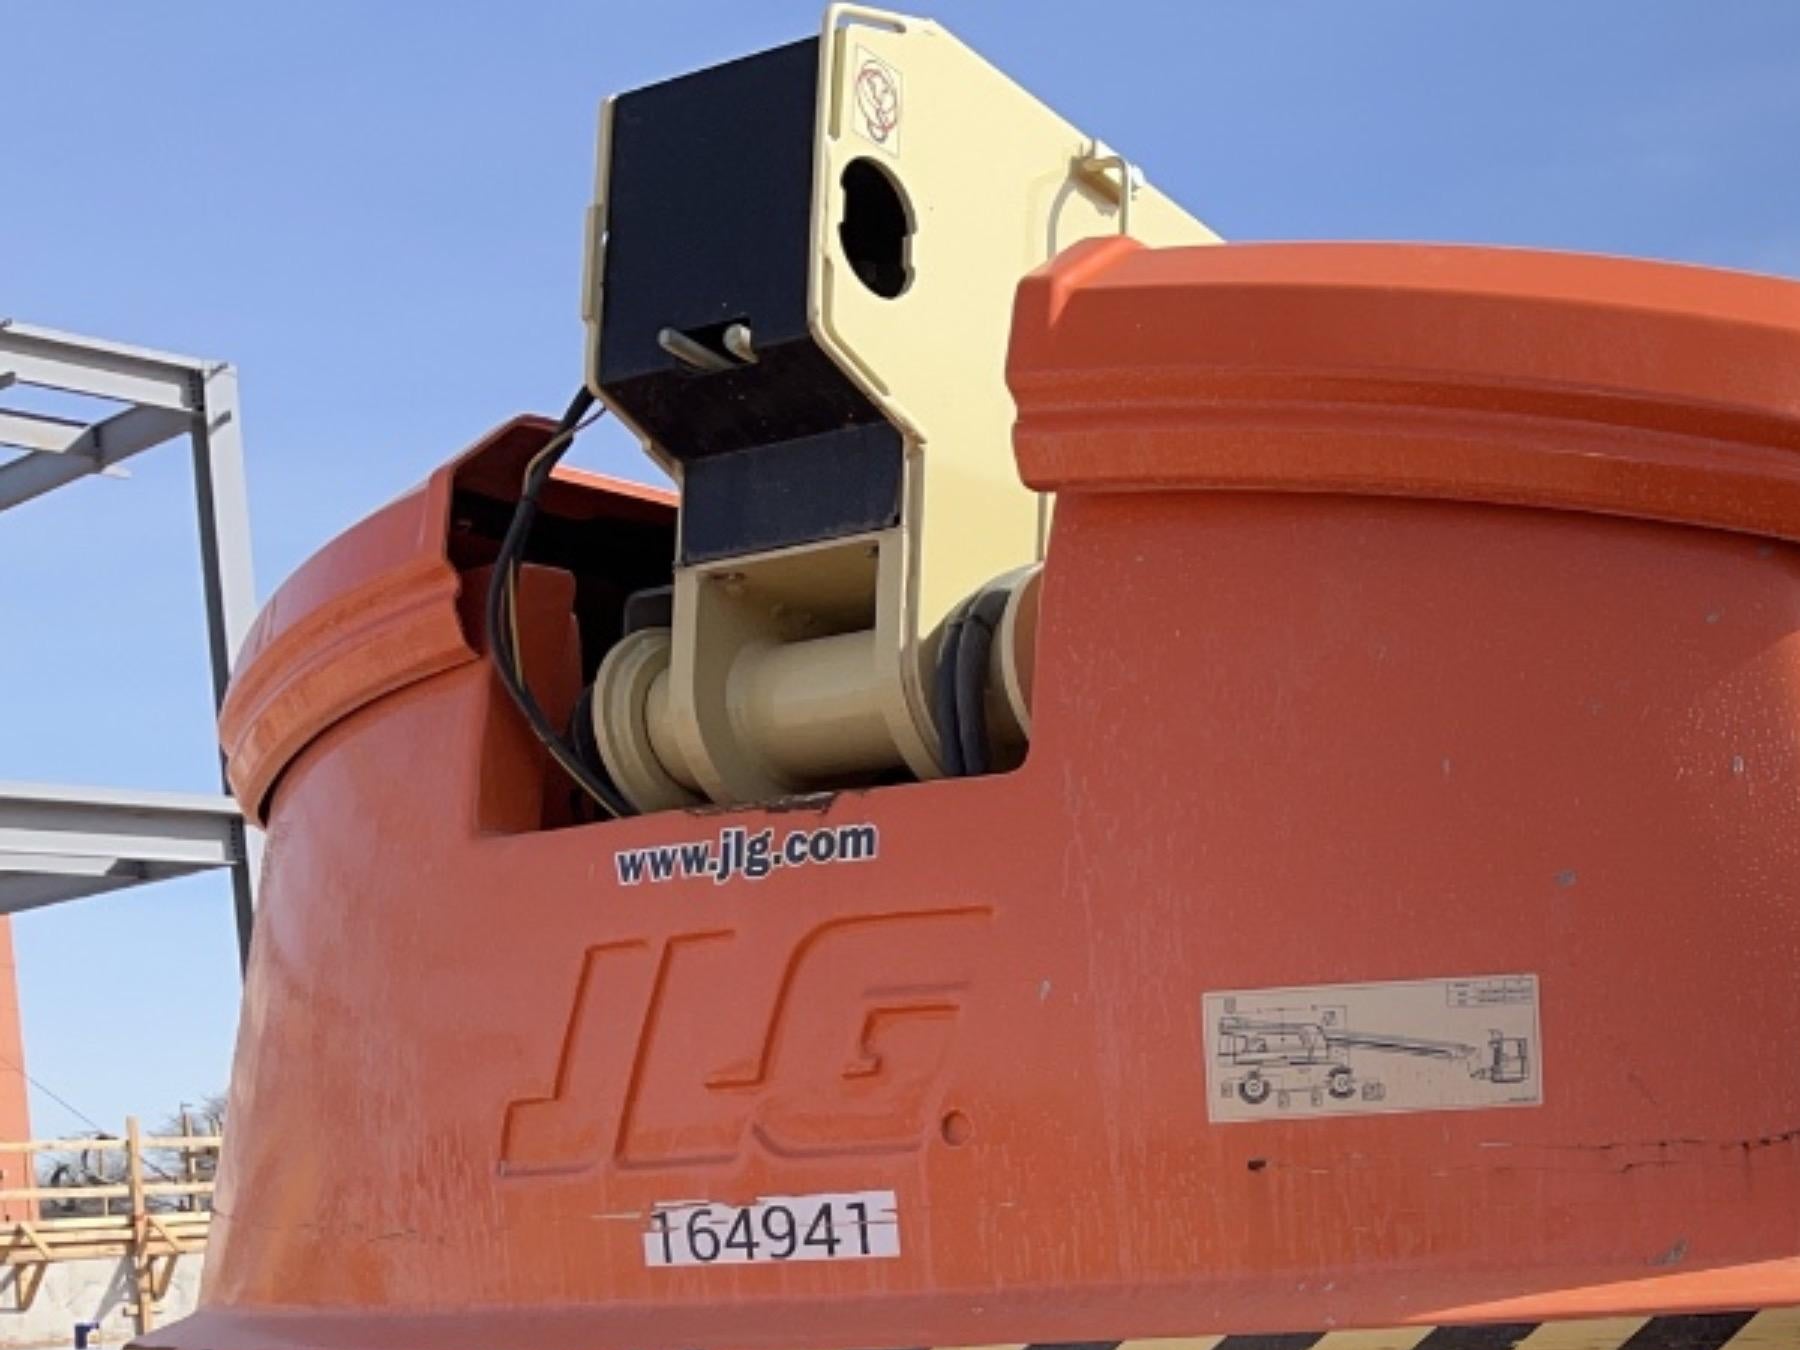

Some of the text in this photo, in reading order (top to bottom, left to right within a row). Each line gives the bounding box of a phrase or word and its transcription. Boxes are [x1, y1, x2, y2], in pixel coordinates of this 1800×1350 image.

[616, 823, 877, 884] www.jlg.com
[497, 904, 994, 1177] JLG
[653, 1202, 872, 1264] 164941
